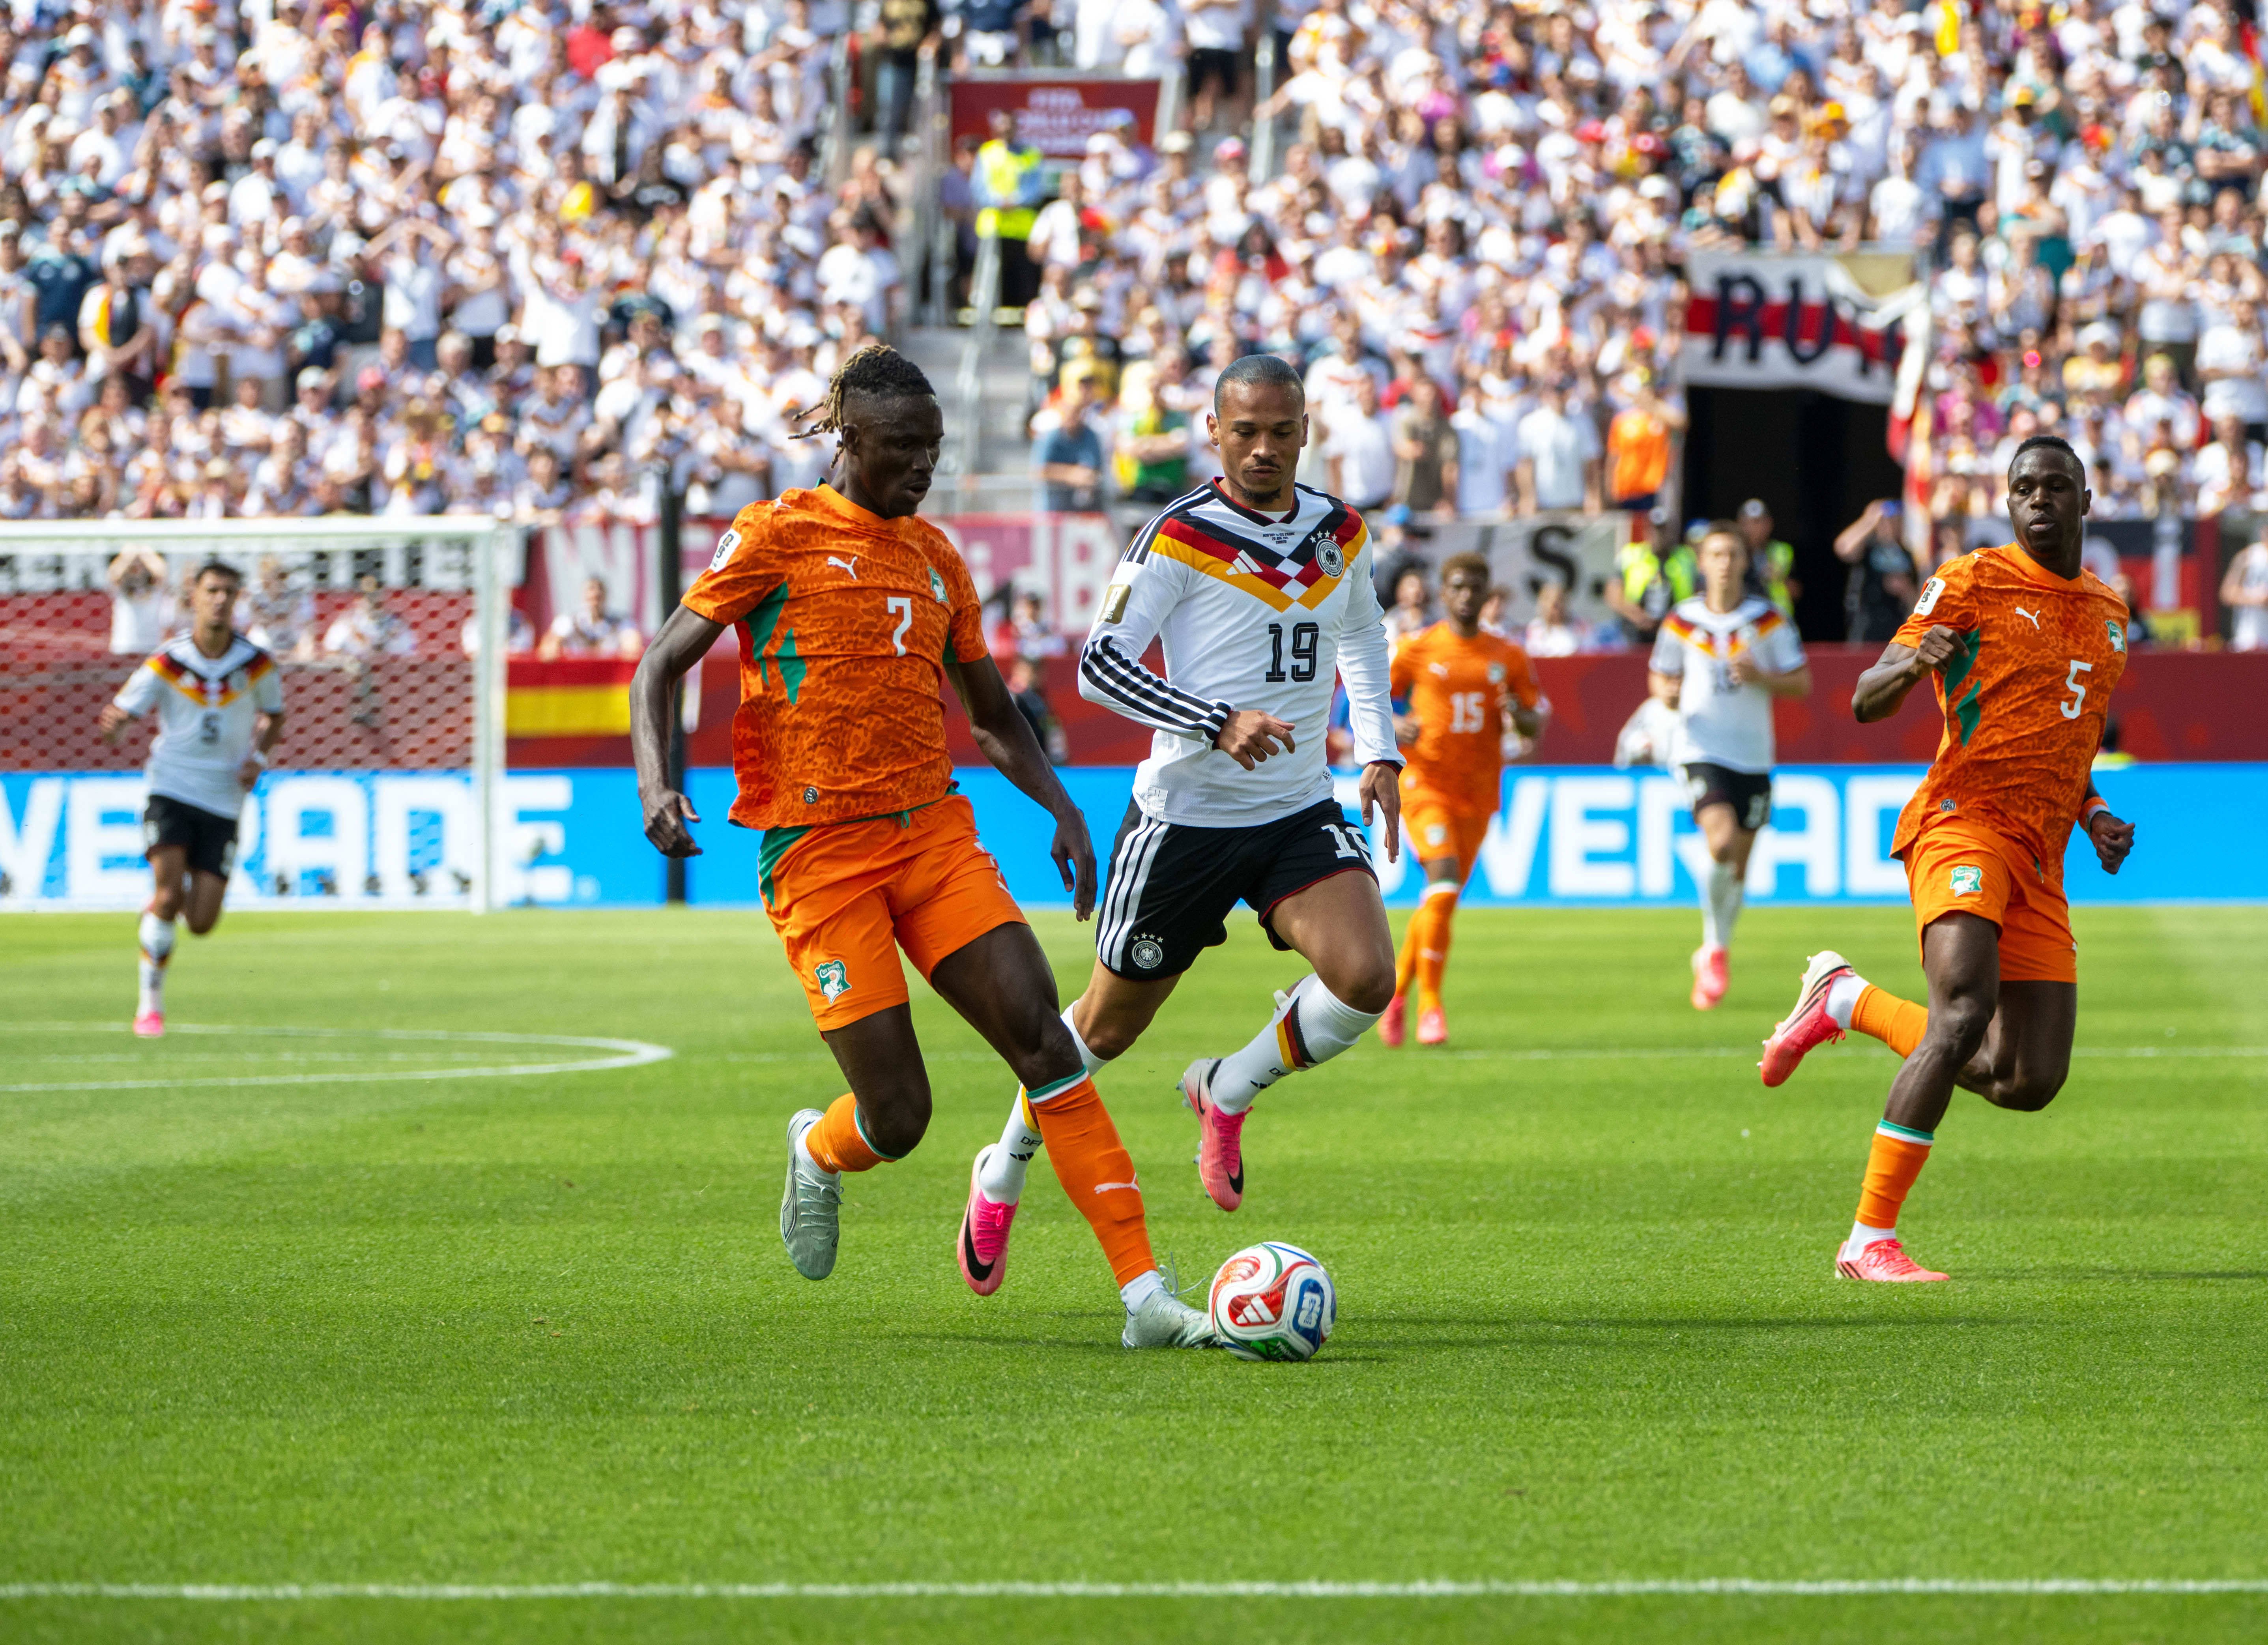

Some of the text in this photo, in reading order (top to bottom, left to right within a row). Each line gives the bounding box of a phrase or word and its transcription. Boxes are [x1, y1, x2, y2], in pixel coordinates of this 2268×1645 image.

[887, 596, 912, 658] 7
[1265, 622, 1319, 682] 19
[1449, 692, 1486, 734] 15
[2060, 659, 2093, 720] 5
